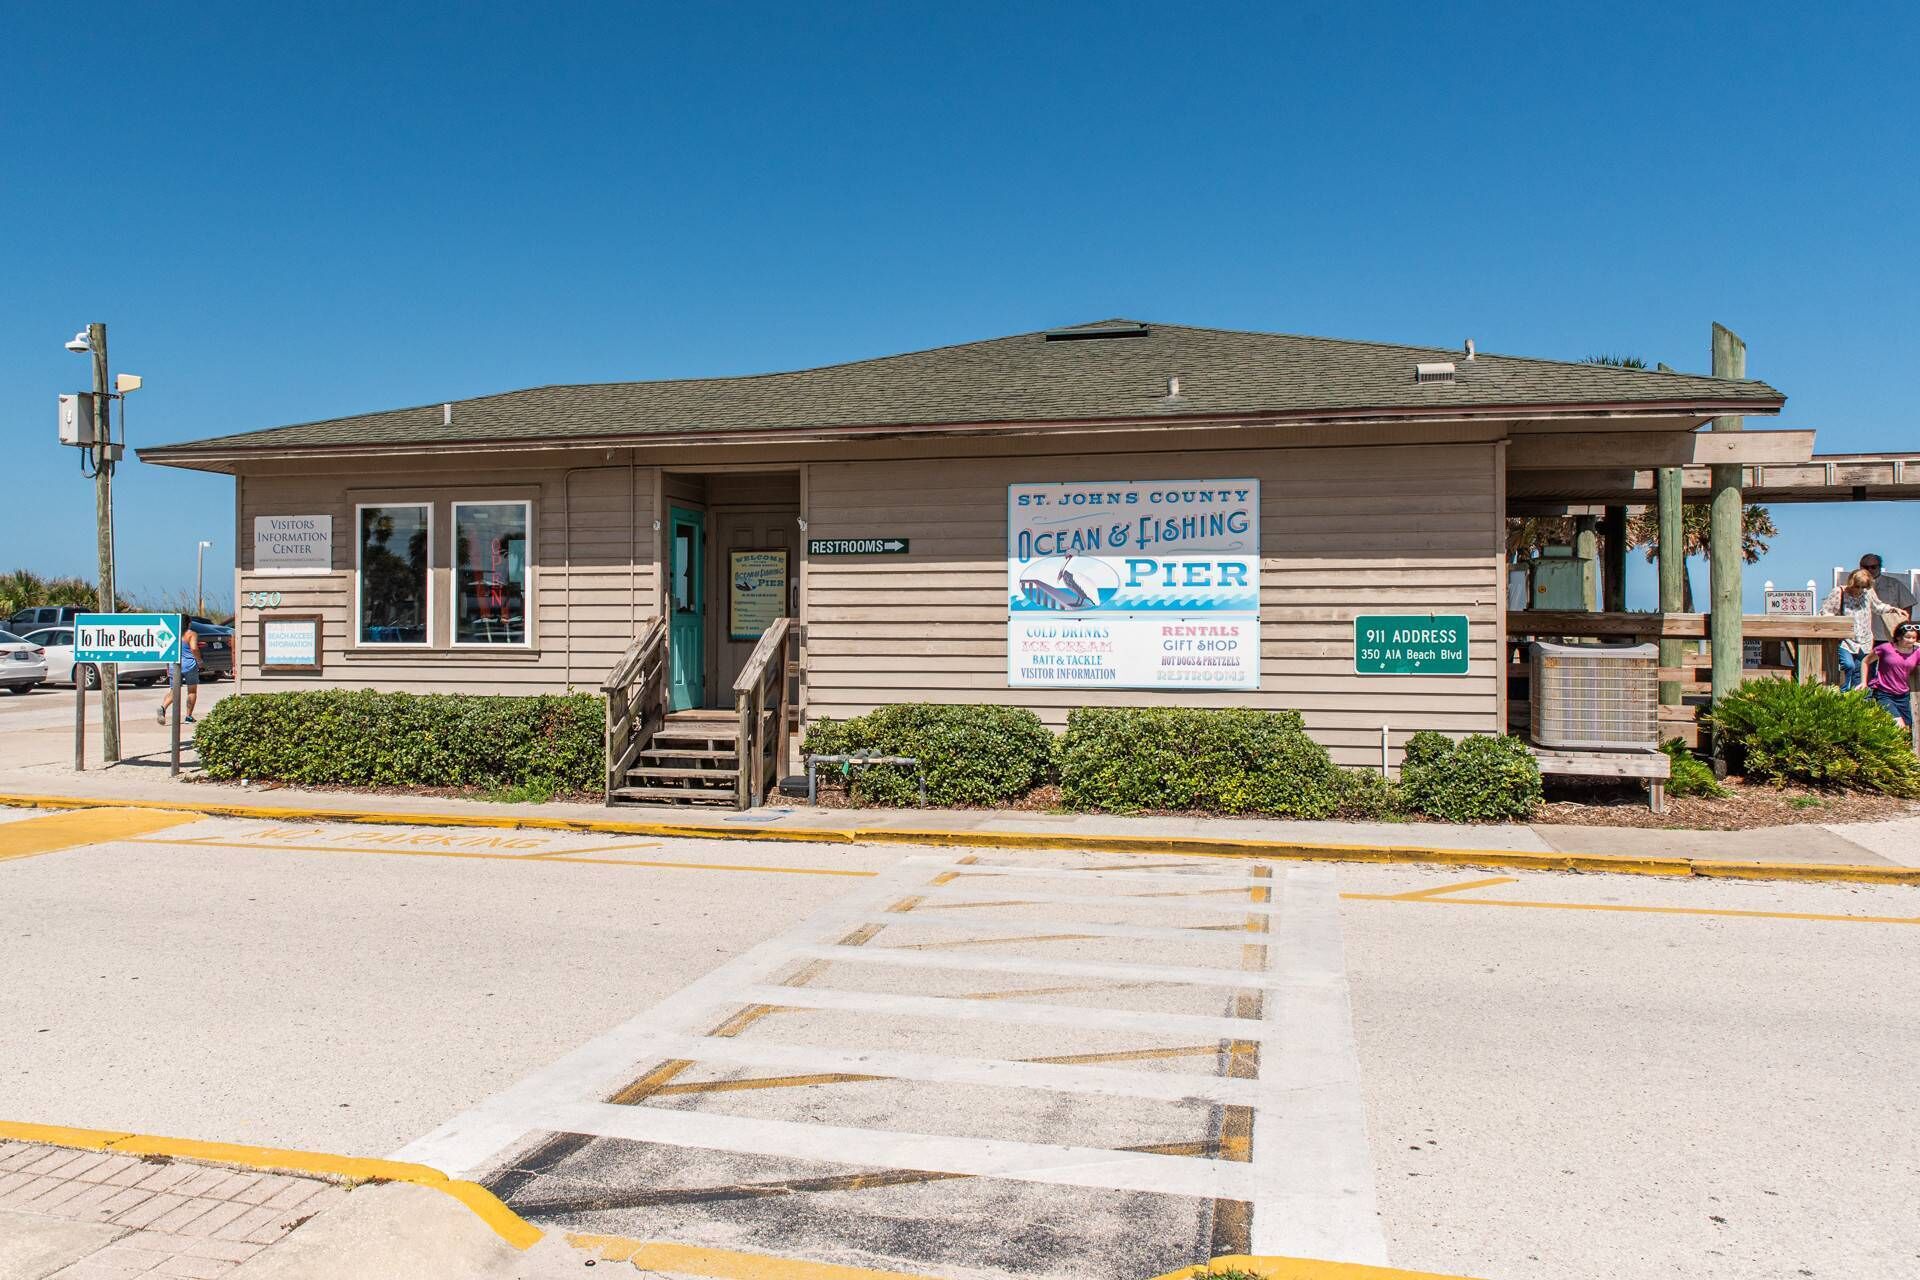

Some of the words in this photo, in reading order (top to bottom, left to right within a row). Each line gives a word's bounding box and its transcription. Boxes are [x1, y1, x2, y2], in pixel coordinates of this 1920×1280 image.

[1018, 493, 1050, 506] ST.
[1059, 492, 1138, 505] JOHNS
[1150, 490, 1249, 504] COUNTY
[270, 519, 315, 530] VISITORS
[258, 531, 328, 543] INFORMATION
[1018, 528, 1100, 563] OCEAN
[1108, 523, 1130, 547] &
[1136, 510, 1250, 550] FISHING
[272, 543, 312, 554] CENTER
[811, 540, 884, 554] RESTROOMS
[1125, 558, 1248, 587] PIER
[758, 579, 785, 587] PIER
[247, 592, 281, 609] 350
[1771, 600, 1780, 608] NO
[1026, 626, 1057, 638] COLD
[1062, 626, 1109, 638] DRINKS
[1162, 626, 1240, 636] RENTALS
[1366, 630, 1385, 643] 911
[1392, 630, 1457, 643] ADDRESS
[80, 629, 92, 647] To
[96, 628, 116, 647] The
[119, 628, 155, 647] Beach
[1163, 640, 1193, 651] GIFT
[1197, 640, 1238, 651] SHOP
[1032, 655, 1055, 665] BAIT
[1066, 655, 1103, 665] TACKLE
[1361, 649, 1380, 660] 350
[1406, 649, 1436, 660] Beach
[1441, 649, 1462, 660] Blvd
[1161, 656, 1176, 666] HOT
[1021, 668, 1054, 679] VISITOR
[1057, 668, 1116, 680] INFORMATION
[1156, 670, 1246, 682] RESTROOMS
[331, 831, 552, 849] PARKING
